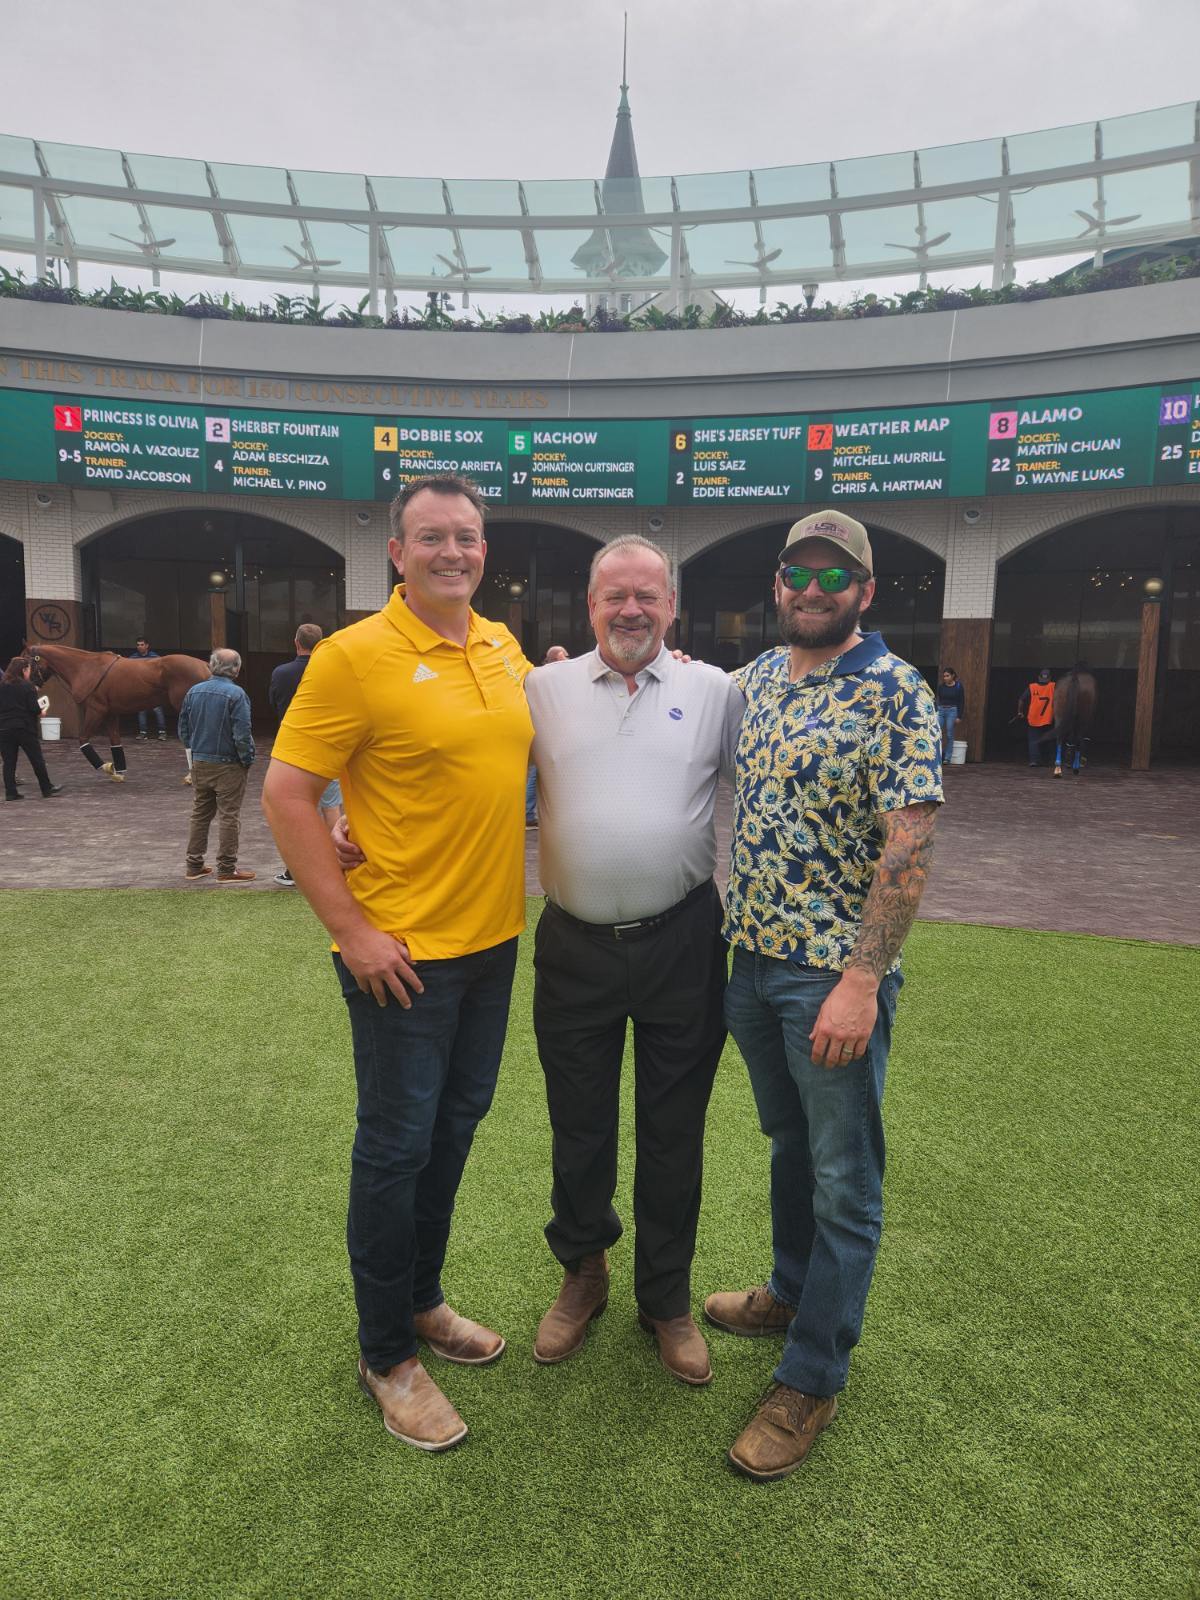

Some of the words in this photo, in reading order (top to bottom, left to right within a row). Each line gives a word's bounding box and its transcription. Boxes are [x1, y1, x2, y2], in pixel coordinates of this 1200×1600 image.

[18, 360, 84, 383] THIS
[91, 367, 183, 393] TRACK
[188, 377, 241, 397] FOR
[247, 381, 286, 398] 150
[295, 384, 464, 407] CONSECUTIVE
[472, 389, 549, 409] YEARS
[1020, 407, 1082, 425] ALAMO
[1163, 400, 1187, 420] 10
[64, 411, 73, 427] 1
[83, 409, 143, 426] PRINCESS
[145, 413, 156, 426] IS
[159, 414, 199, 430] OLIVIA
[997, 418, 1009, 433] 8
[212, 423, 223, 438] 2
[232, 421, 280, 434] SHERBET
[282, 422, 339, 438] FOUNTAIN
[835, 420, 910, 437] WEATHER
[915, 417, 950, 432] MAP
[84, 431, 123, 442] JOCKEY:
[381, 432, 390, 446] 4
[400, 429, 451, 443] BOBBIE
[455, 430, 483, 443] SOX
[533, 432, 597, 445] KACHOW
[694, 429, 725, 443] SHE'S
[727, 428, 770, 442] JERSEY
[773, 426, 802, 440] TUFF
[815, 430, 825, 445] 7
[1018, 433, 1060, 444] JOCKEY:
[233, 441, 269, 451] JOCKEY:
[514, 435, 525, 451] 5
[675, 434, 686, 450] 6
[1017, 442, 1068, 457] MARTIN
[1071, 437, 1121, 452] CHUAN
[58, 449, 81, 463] 9-5
[85, 441, 130, 453] RAMON
[146, 445, 199, 459] VAZQUEZ
[400, 449, 434, 458] JOCKEY:
[532, 452, 566, 461] JOCKEY:
[693, 451, 729, 460] JOCKEY:
[834, 445, 871, 455] JOCKEY:
[1161, 445, 1183, 460] 25
[85, 456, 126, 467] TRAINER:
[233, 451, 266, 462] ADAM
[268, 452, 330, 466] BESCHIZZA
[400, 459, 458, 471] FRANCISCO
[461, 460, 502, 472] ARRIETA
[833, 454, 892, 467] MITCHELL
[894, 451, 945, 464] MURRILL
[991, 458, 1010, 473] 22
[214, 460, 224, 472] 4
[233, 466, 271, 476] TRAINER:
[532, 461, 583, 472] JOHNATHON
[584, 460, 634, 474] CURTSINGER
[693, 460, 718, 472] LUIS
[719, 460, 746, 471] SAEZ
[1016, 461, 1060, 471] TRAINER:
[86, 467, 123, 479] DAVID
[126, 469, 191, 483] JACOBSON
[382, 468, 390, 481] 6
[512, 472, 527, 484] 17
[532, 477, 568, 486] TRAINER:
[676, 473, 684, 485] 2
[693, 477, 730, 486] TRAINER:
[814, 468, 823, 481] 9
[832, 472, 872, 482] TRAINER:
[1016, 473, 1029, 486] D.
[1032, 471, 1079, 484] WAYNE
[1082, 467, 1125, 482] LUKAS
[233, 477, 283, 489] MICHAEL
[286, 479, 296, 489] V.
[299, 480, 326, 491] PINO
[832, 482, 867, 494] CHRIS
[882, 479, 942, 494] HARTMAN
[532, 487, 570, 498] MARVIN
[572, 487, 634, 500] CURTSINGER
[692, 487, 725, 498] EDDIE
[727, 485, 790, 497] KENNEALLY
[1039, 697, 1050, 716] 7
